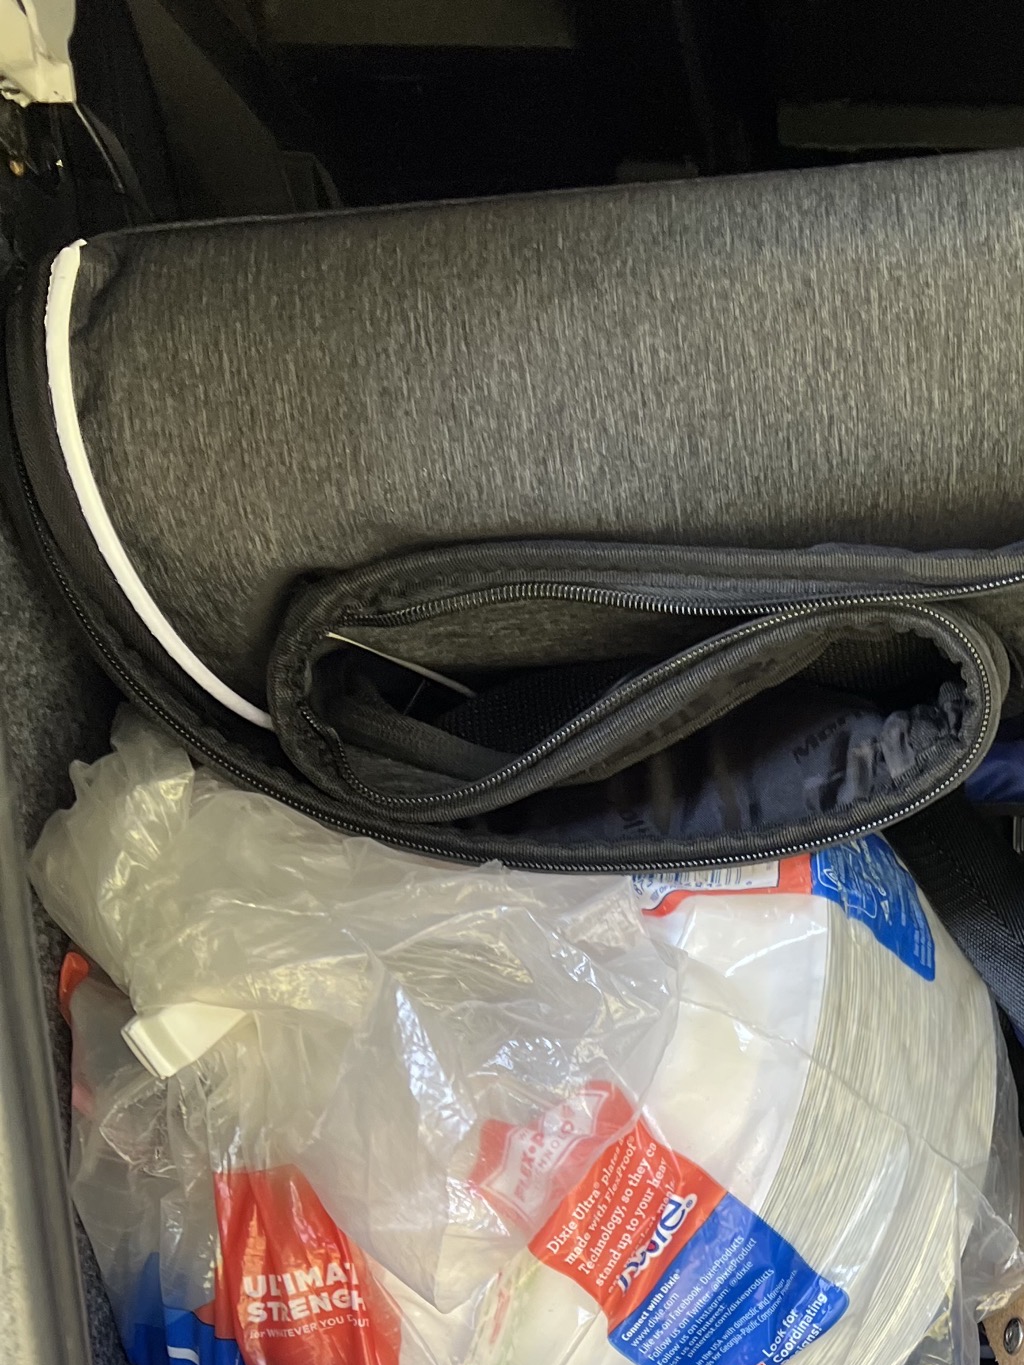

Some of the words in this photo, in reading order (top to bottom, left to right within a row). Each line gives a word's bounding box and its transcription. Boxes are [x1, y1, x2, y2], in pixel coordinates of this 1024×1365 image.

[546, 1220, 578, 1254] Dixie
[564, 1231, 591, 1265] made
[588, 1204, 608, 1233] with
[578, 1205, 628, 1275] Technology,
[620, 1188, 634, 1204] so
[628, 1157, 650, 1188] they
[595, 1249, 622, 1287] stand
[617, 1233, 633, 1250] up
[626, 1218, 639, 1232] to
[635, 1190, 655, 1219] your
[320, 1316, 345, 1328] YOU
[621, 1314, 649, 1341] Connect
[646, 1296, 664, 1313] with
[631, 1292, 679, 1347] www.dixie.com
[638, 1337, 655, 1355] Like
[653, 1329, 664, 1341] us
[662, 1319, 673, 1331] on
[699, 1234, 745, 1285] DixieProducts
[648, 1338, 671, 1362] Follow
[670, 1328, 681, 1340] us
[679, 1317, 689, 1329] on
[679, 1333, 690, 1344] us
[688, 1323, 699, 1335] on
[681, 1346, 690, 1357] us
[688, 1336, 699, 1347] on
[701, 1348, 712, 1361] the
[710, 1338, 723, 1353] USA
[722, 1327, 736, 1340] with
[733, 1305, 760, 1331] domestic
[757, 1297, 770, 1311] and
[713, 1351, 723, 1363] for
[721, 1318, 761, 1355] Georgia-Pacific
[757, 1297, 783, 1324] Consumer
[762, 1329, 786, 1358] Look
[782, 1308, 800, 1328] for
[773, 1292, 828, 1363] Coordinating
